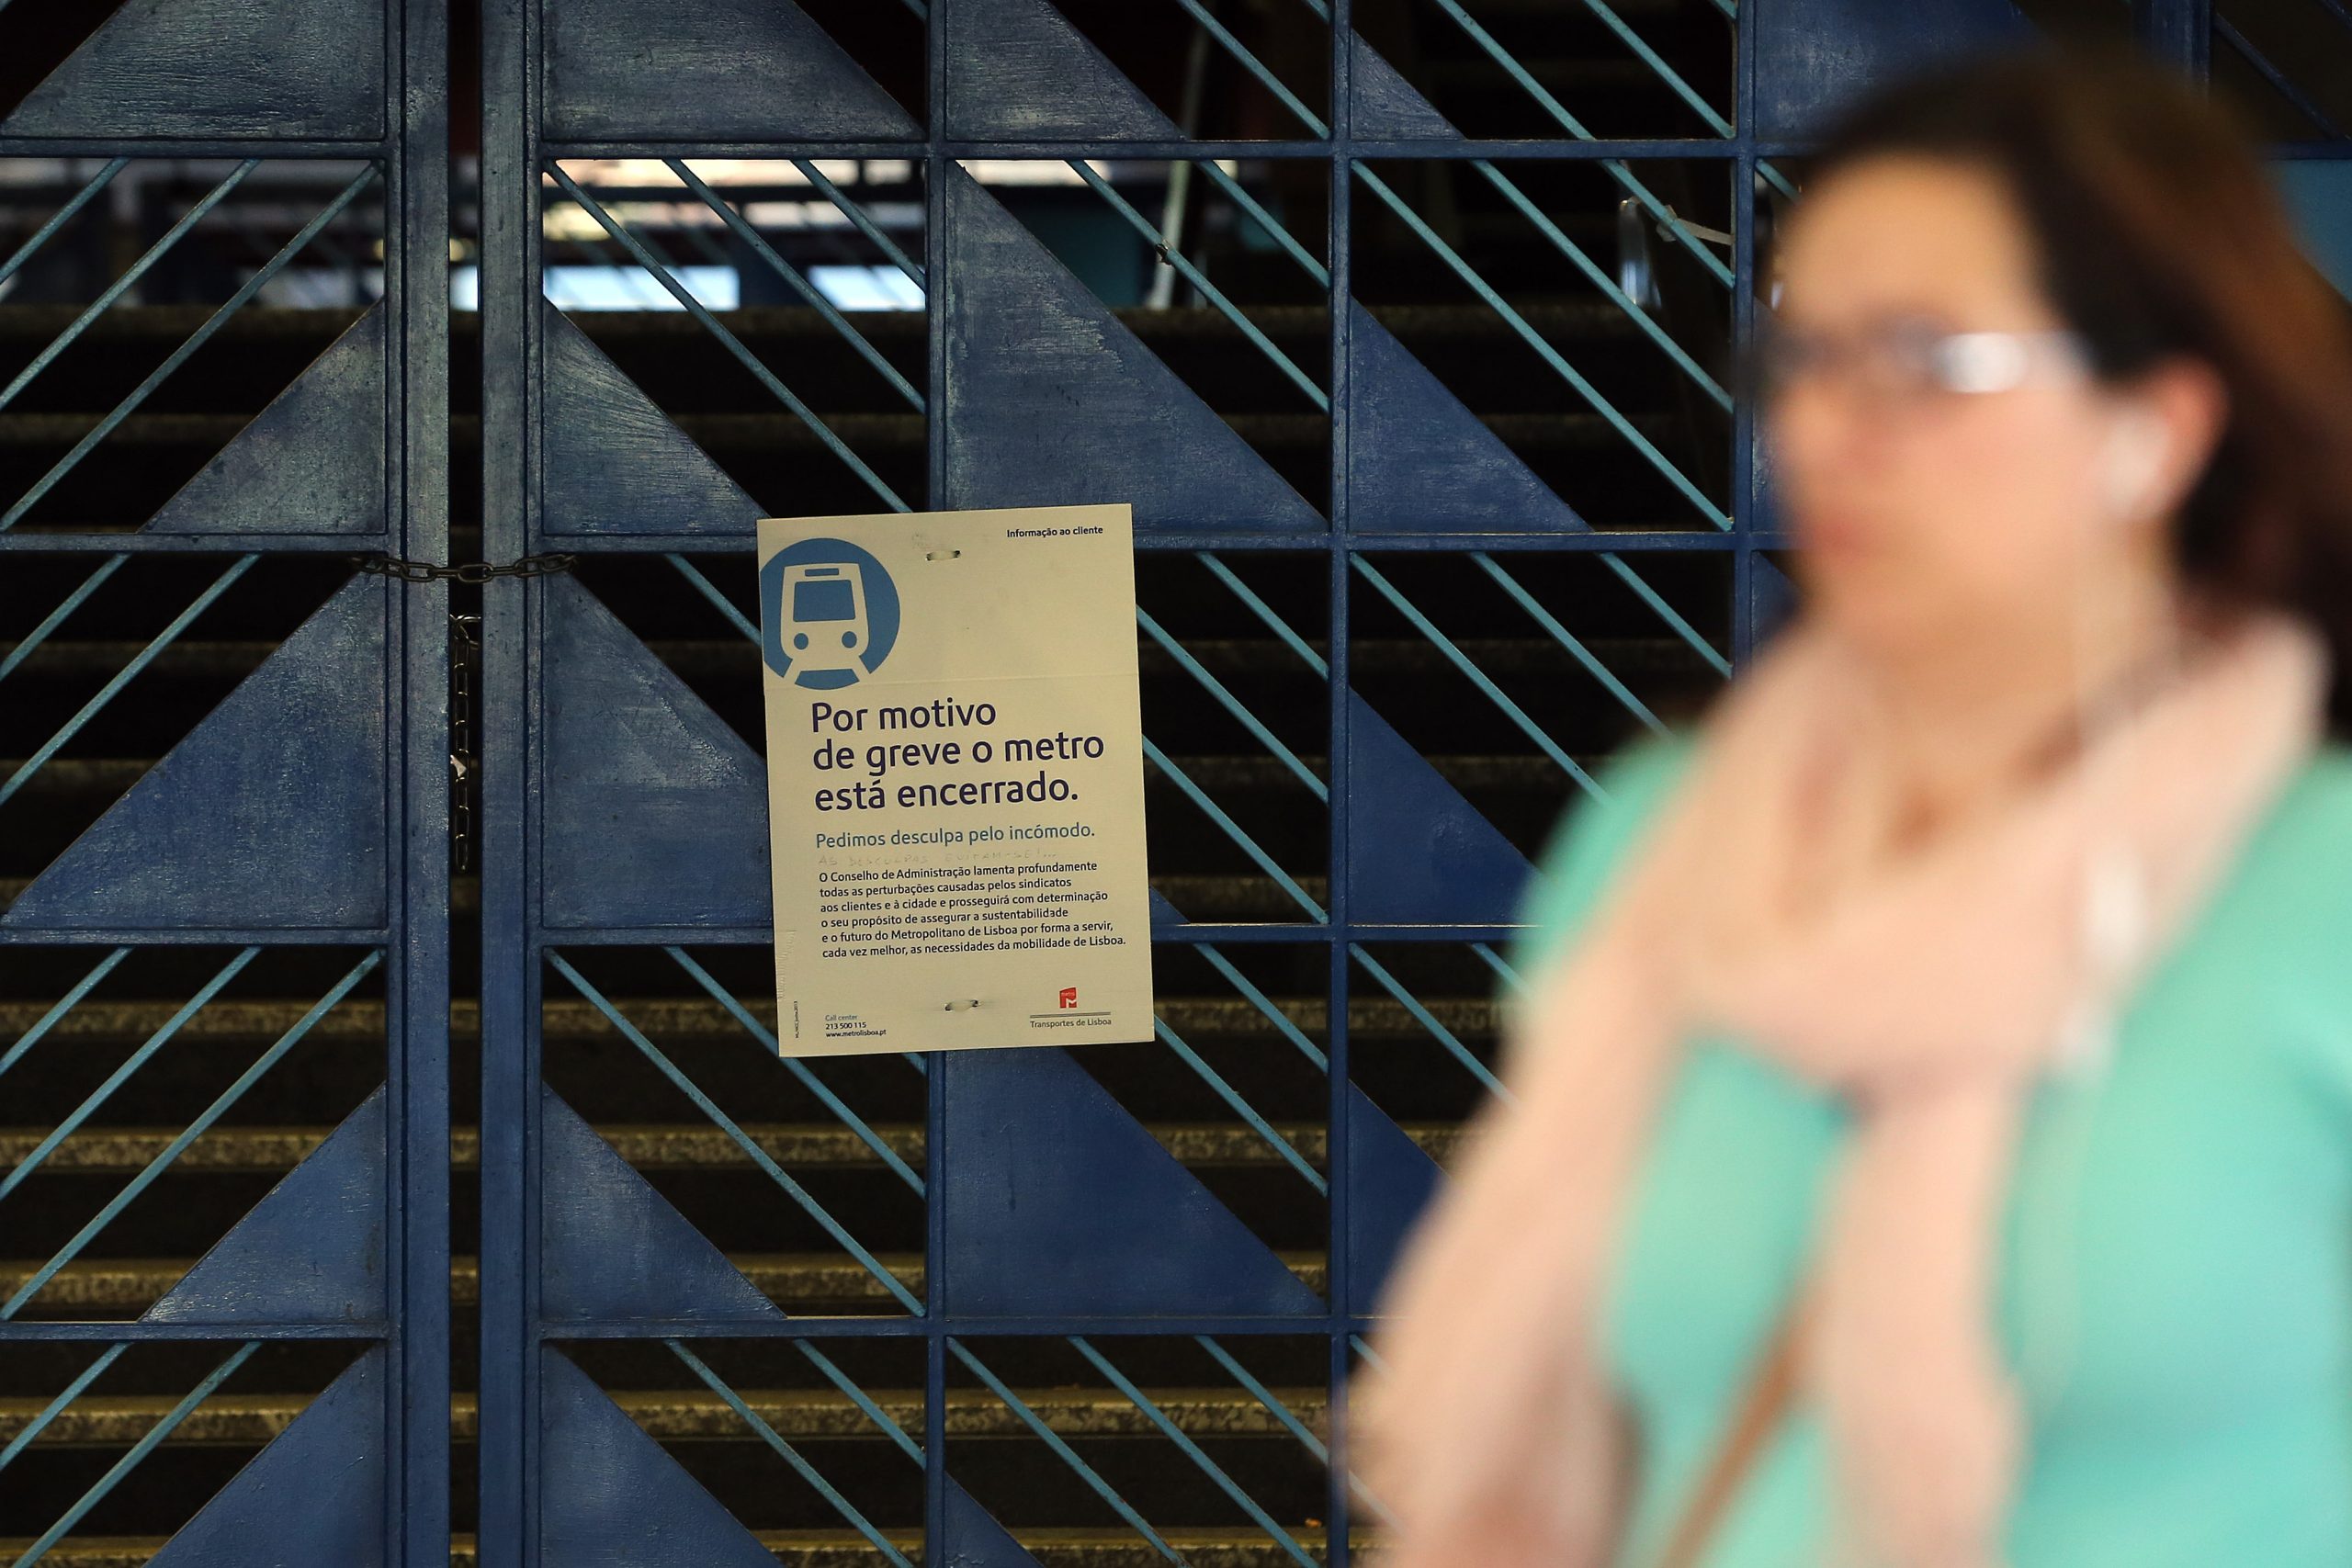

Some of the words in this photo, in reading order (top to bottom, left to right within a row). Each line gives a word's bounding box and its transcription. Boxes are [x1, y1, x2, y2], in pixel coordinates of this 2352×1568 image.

[1006, 528, 1058, 537] Informação
[1058, 528, 1071, 536] ao
[1072, 526, 1103, 535] cliente
[812, 703, 868, 732] Por
[879, 697, 996, 729] motivo
[814, 739, 854, 770] de
[866, 743, 960, 776] greve
[973, 741, 992, 762] o
[1005, 732, 1103, 761] metro
[816, 778, 885, 811] está
[898, 771, 1078, 807] encerrado.
[817, 832, 886, 848] Pedimos
[891, 828, 963, 847] desculpa
[969, 826, 1004, 845] pelo
[1010, 822, 1094, 840] incómodo.
[830, 871, 879, 882] Conselho
[881, 868, 896, 880] de
[896, 867, 971, 879] Administração
[973, 865, 1015, 875] lamenta
[1017, 862, 1098, 874] profundamente
[819, 886, 850, 897] todas
[851, 887, 864, 897] as
[865, 884, 935, 897] perturbações
[936, 881, 986, 892] causadas
[987, 879, 1016, 892] pelos
[1018, 878, 1072, 888] sindicatos
[820, 904, 839, 913] aos
[841, 901, 883, 911] clientes
[901, 898, 937, 908] cidade
[948, 895, 1010, 908] prosseguirá
[1012, 896, 1035, 905] com
[1036, 891, 1108, 903] determinação
[831, 919, 849, 928] seu
[851, 916, 902, 927] propósito
[904, 913, 919, 924] de
[920, 914, 971, 925] assegurar
[981, 909, 1069, 920] sustentabilidade
[839, 932, 873, 942] futuro
[874, 930, 889, 942] do
[890, 928, 966, 941] Metropolitano
[967, 925, 981, 937] de
[983, 925, 1018, 935] Lisboa
[1020, 925, 1039, 937] por
[1040, 923, 1071, 932] forma
[1081, 920, 1114, 931] servir,
[821, 947, 847, 957] cada
[849, 948, 868, 957] vez
[869, 945, 909, 955] melhor,
[910, 945, 922, 954] as
[924, 942, 995, 953] necessidades
[997, 939, 1011, 951] da
[1012, 937, 1071, 949] mobilidade
[1073, 936, 1087, 947] de
[1089, 935, 1126, 945] Lisboa.
[825, 1022, 839, 1031] 213
[839, 1021, 854, 1030] 500
[1029, 1021, 1075, 1029] Transportes
[1075, 1018, 1086, 1027] de
